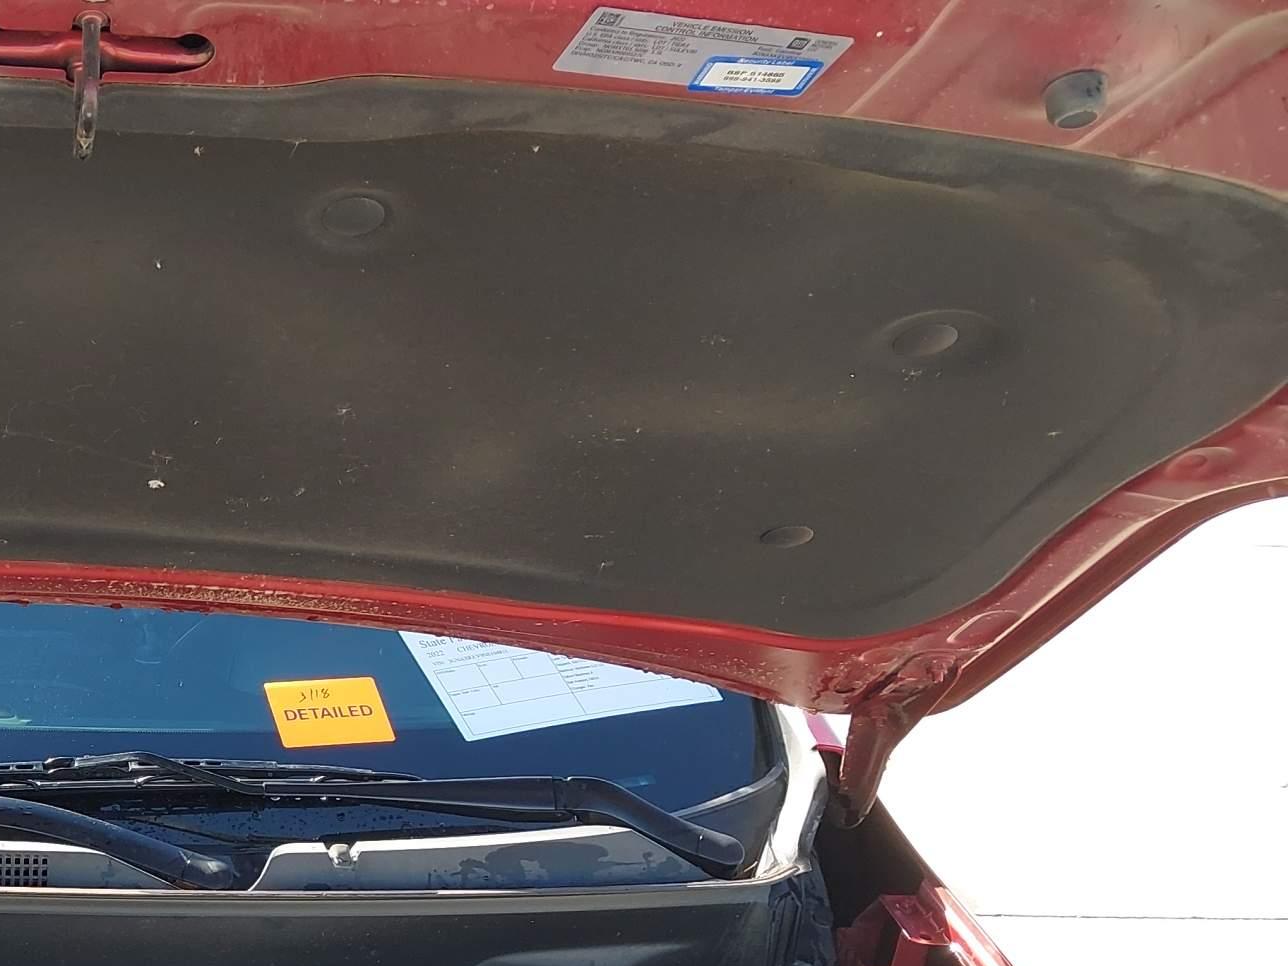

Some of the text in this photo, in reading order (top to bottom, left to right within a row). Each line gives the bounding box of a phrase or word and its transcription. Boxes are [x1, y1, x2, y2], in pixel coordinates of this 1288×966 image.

[655, 25, 759, 42] CONTROL INFORMATION
[672, 21, 754, 36] VEHICLE EMISSION
[418, 639, 447, 650] State
[426, 649, 446, 658] 2022
[285, 704, 373, 722] DETAILED
